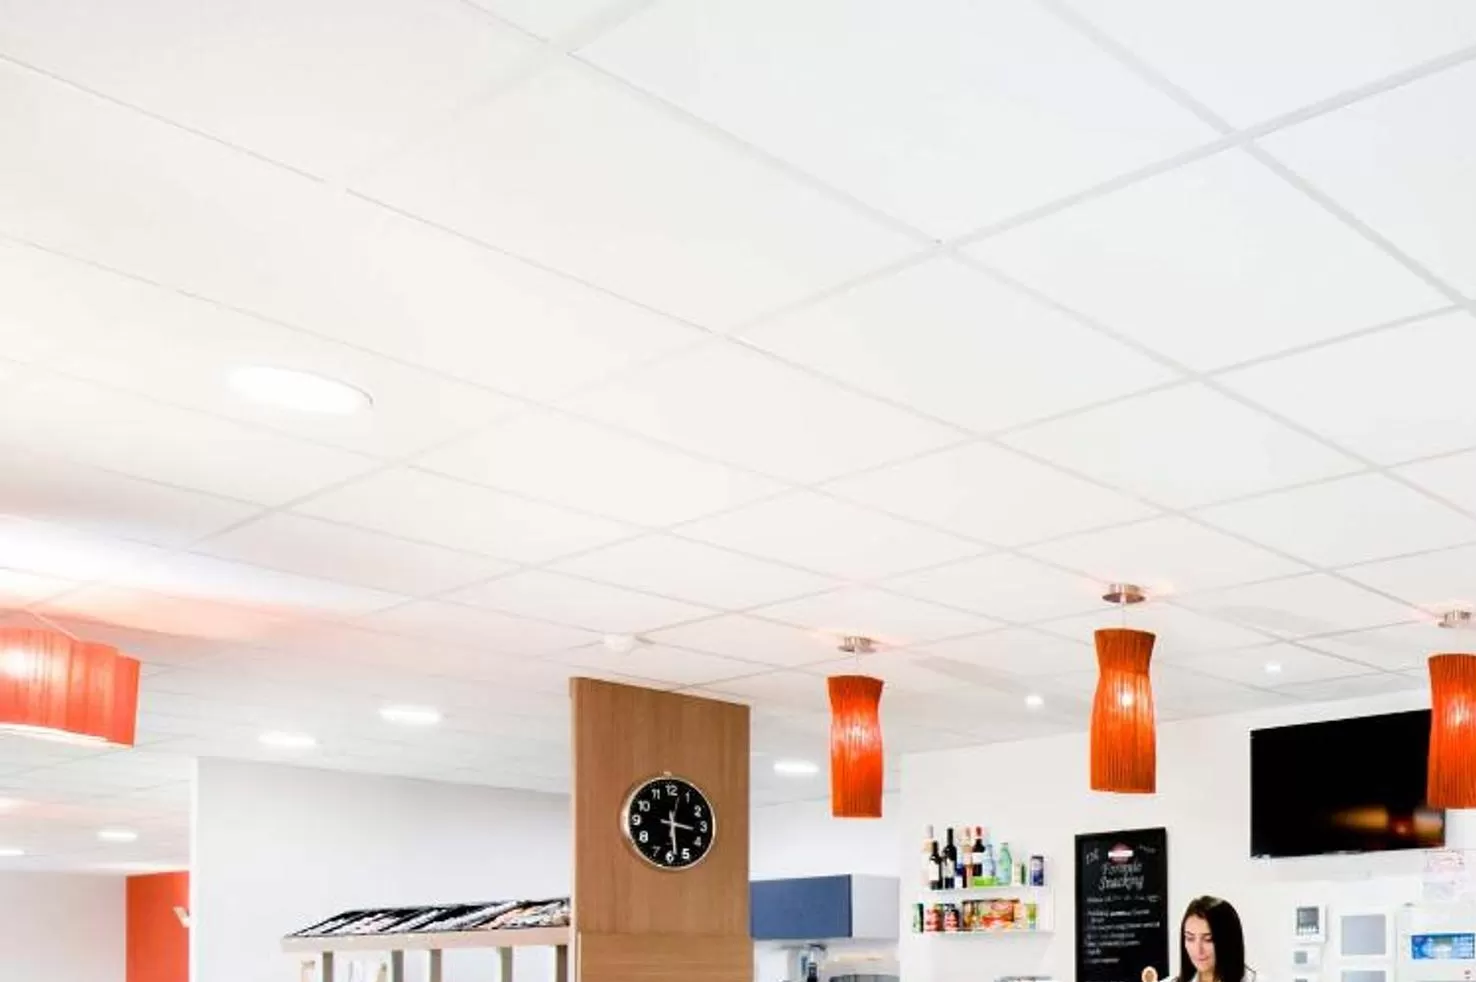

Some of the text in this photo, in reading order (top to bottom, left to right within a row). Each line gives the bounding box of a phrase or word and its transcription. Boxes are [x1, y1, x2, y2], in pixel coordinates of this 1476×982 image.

[651, 789, 660, 800] 11
[665, 784, 678, 796] 12
[685, 791, 690, 804] 1
[638, 800, 650, 812] 10
[694, 805, 702, 818] 2
[632, 814, 641, 826] 9
[700, 821, 708, 833] 3
[639, 830, 648, 843] 8
[694, 837, 702, 846] 4
[652, 846, 661, 857] 7
[665, 851, 674, 863] 6
[682, 847, 690, 860] 5
